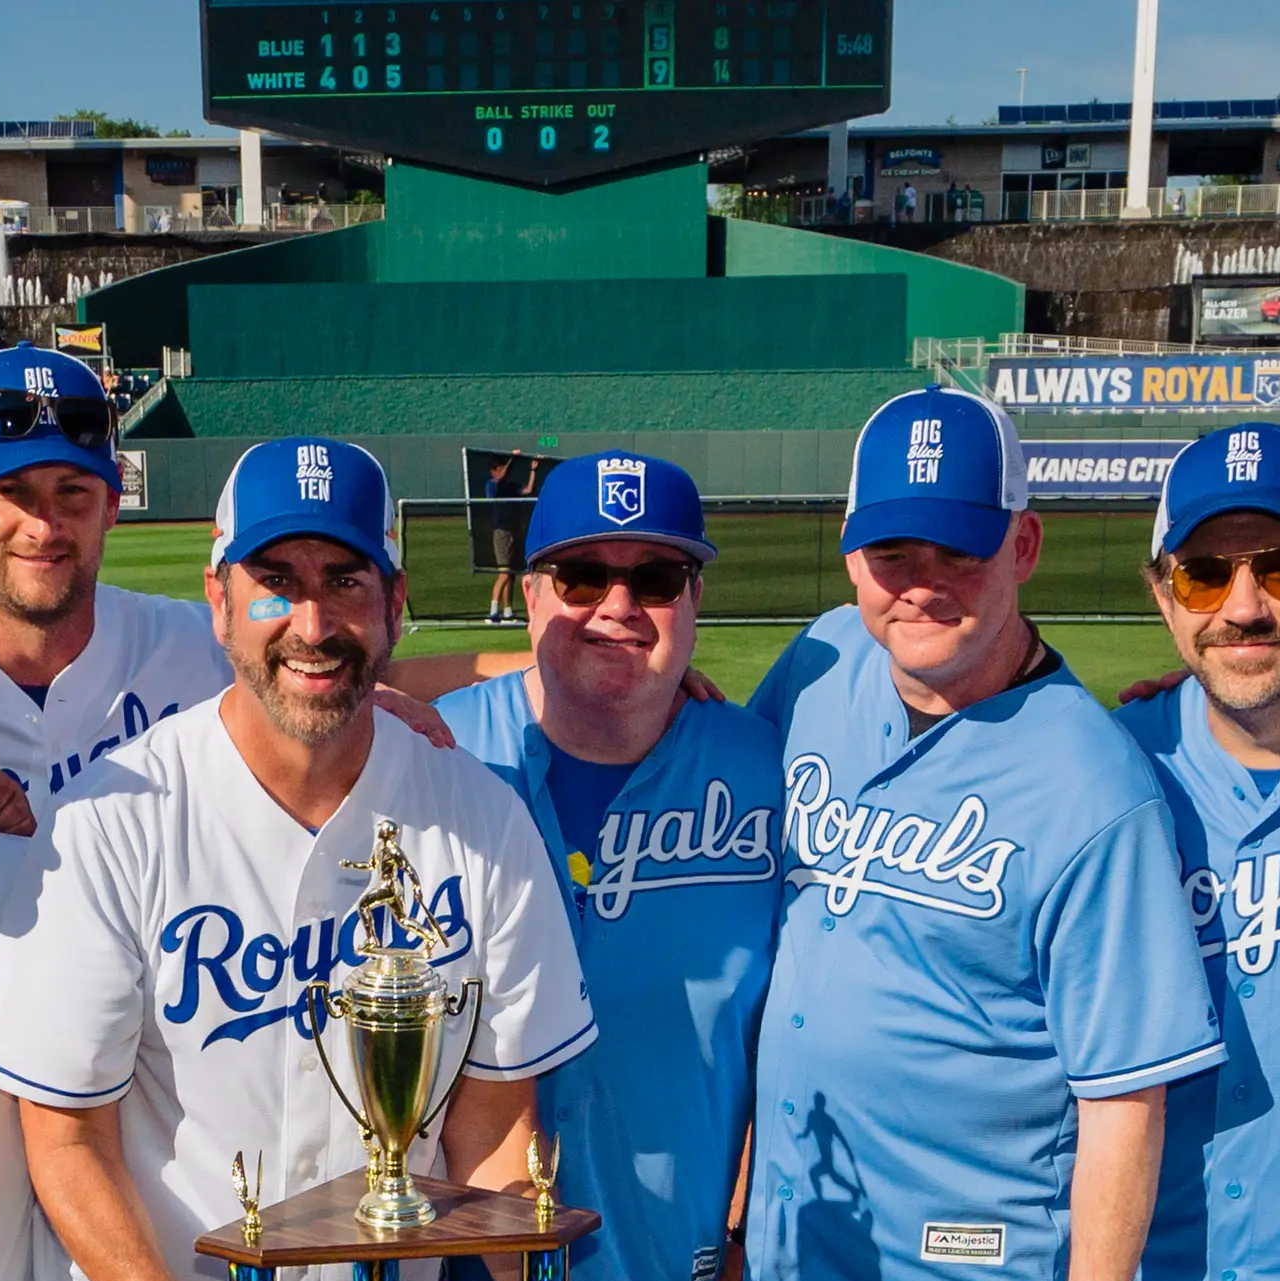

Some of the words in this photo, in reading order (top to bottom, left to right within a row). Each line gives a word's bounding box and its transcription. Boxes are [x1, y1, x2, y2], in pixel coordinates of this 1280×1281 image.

[354, 10, 363, 23] 2
[258, 40, 304, 57] BLUE
[321, 34, 332, 57] 1
[354, 33, 365, 57] 1
[386, 33, 401, 56] 3
[653, 28, 667, 50] 5
[837, 33, 872, 55] 5:48
[247, 72, 305, 89] WHITE
[321, 66, 336, 89] 4
[353, 65, 368, 88] 0
[386, 65, 401, 88] 5
[653, 60, 667, 83] 9
[714, 59, 730, 82] 14
[475, 107, 513, 119] BALL
[521, 105, 574, 118] STRIKE
[588, 104, 616, 117] OUT
[487, 127, 502, 150] 0
[540, 126, 556, 149] 0
[594, 125, 609, 148] 2
[1204, 308, 1248, 319] BLAZER
[24, 367, 55, 389] BIG
[994, 367, 1132, 403] ALWAYS
[1142, 366, 1253, 402] ROYAL
[1258, 376, 1280, 397] KC
[910, 419, 942, 445] BIG
[1228, 431, 1259, 451] BIG
[297, 444, 329, 466] BIG
[907, 443, 944, 459] Slick
[1225, 449, 1263, 464] Slick
[296, 464, 333, 480] Slick
[908, 459, 939, 484] TEN
[1027, 457, 1127, 482] KANSAS
[1128, 457, 1173, 482] CIT
[1226, 461, 1259, 483] TEN
[298, 478, 330, 502] TEN
[606, 481, 638, 512] KC
[782, 752, 1018, 919] Royals
[951, 1234, 995, 1247] Majestic
